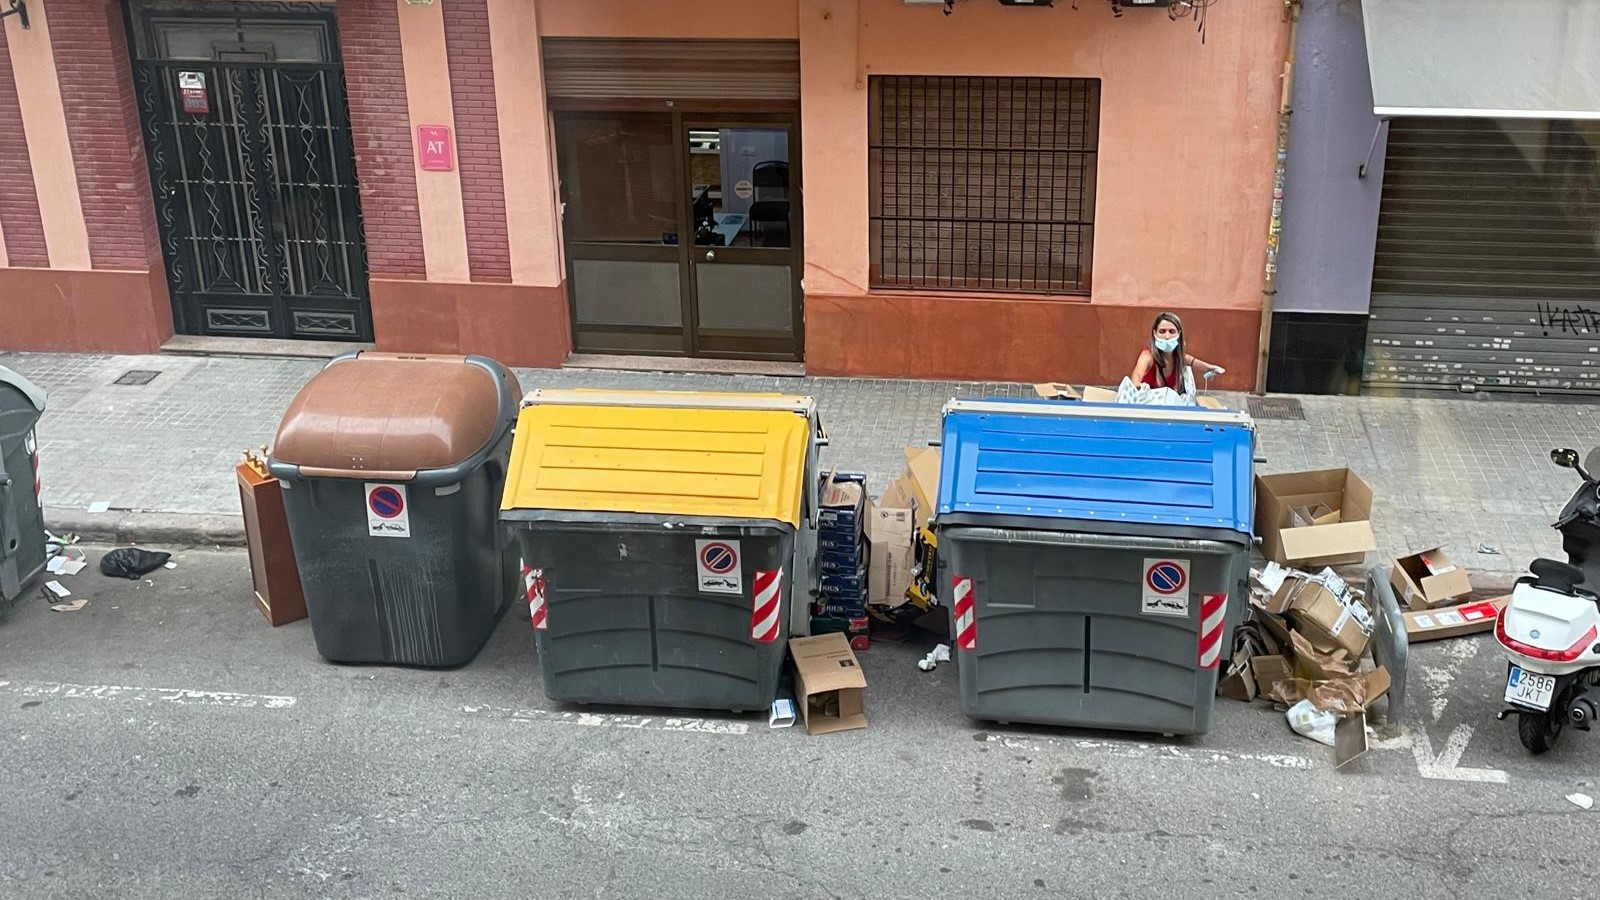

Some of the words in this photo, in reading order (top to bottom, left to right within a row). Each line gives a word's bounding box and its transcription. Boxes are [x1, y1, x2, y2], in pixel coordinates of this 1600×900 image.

[426, 140, 445, 155] AT
[1519, 672, 1554, 692] 2586
[1517, 687, 1547, 702] JKT
